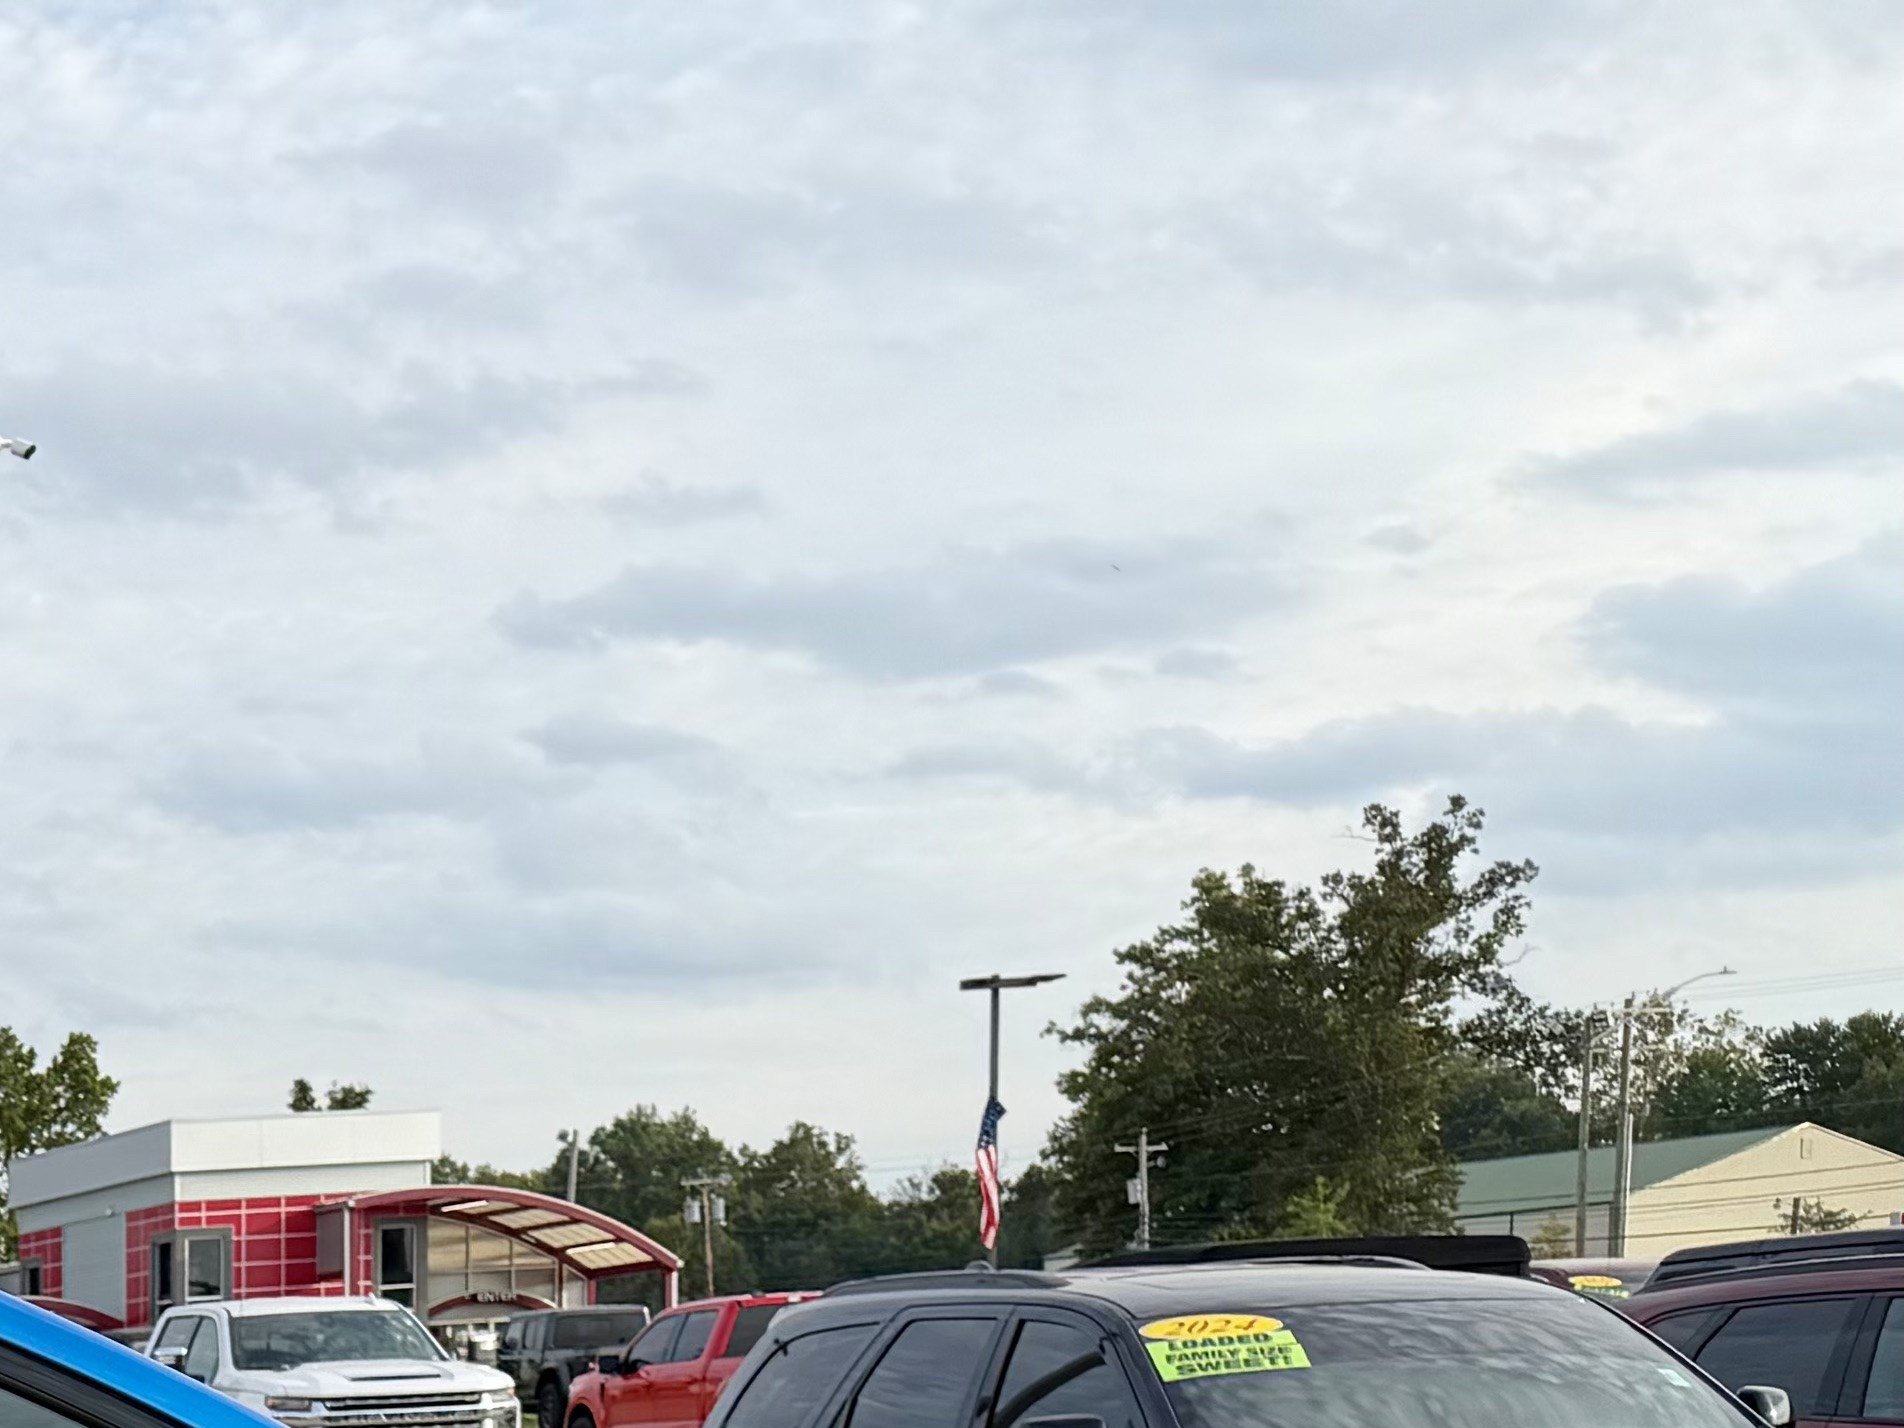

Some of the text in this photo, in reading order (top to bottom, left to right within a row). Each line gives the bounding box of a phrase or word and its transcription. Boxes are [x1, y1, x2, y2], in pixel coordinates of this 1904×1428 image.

[1164, 1318, 1259, 1337] 2024
[1168, 1332, 1273, 1352] LOADED
[1165, 1346, 1293, 1365] FAMILY SIZE
